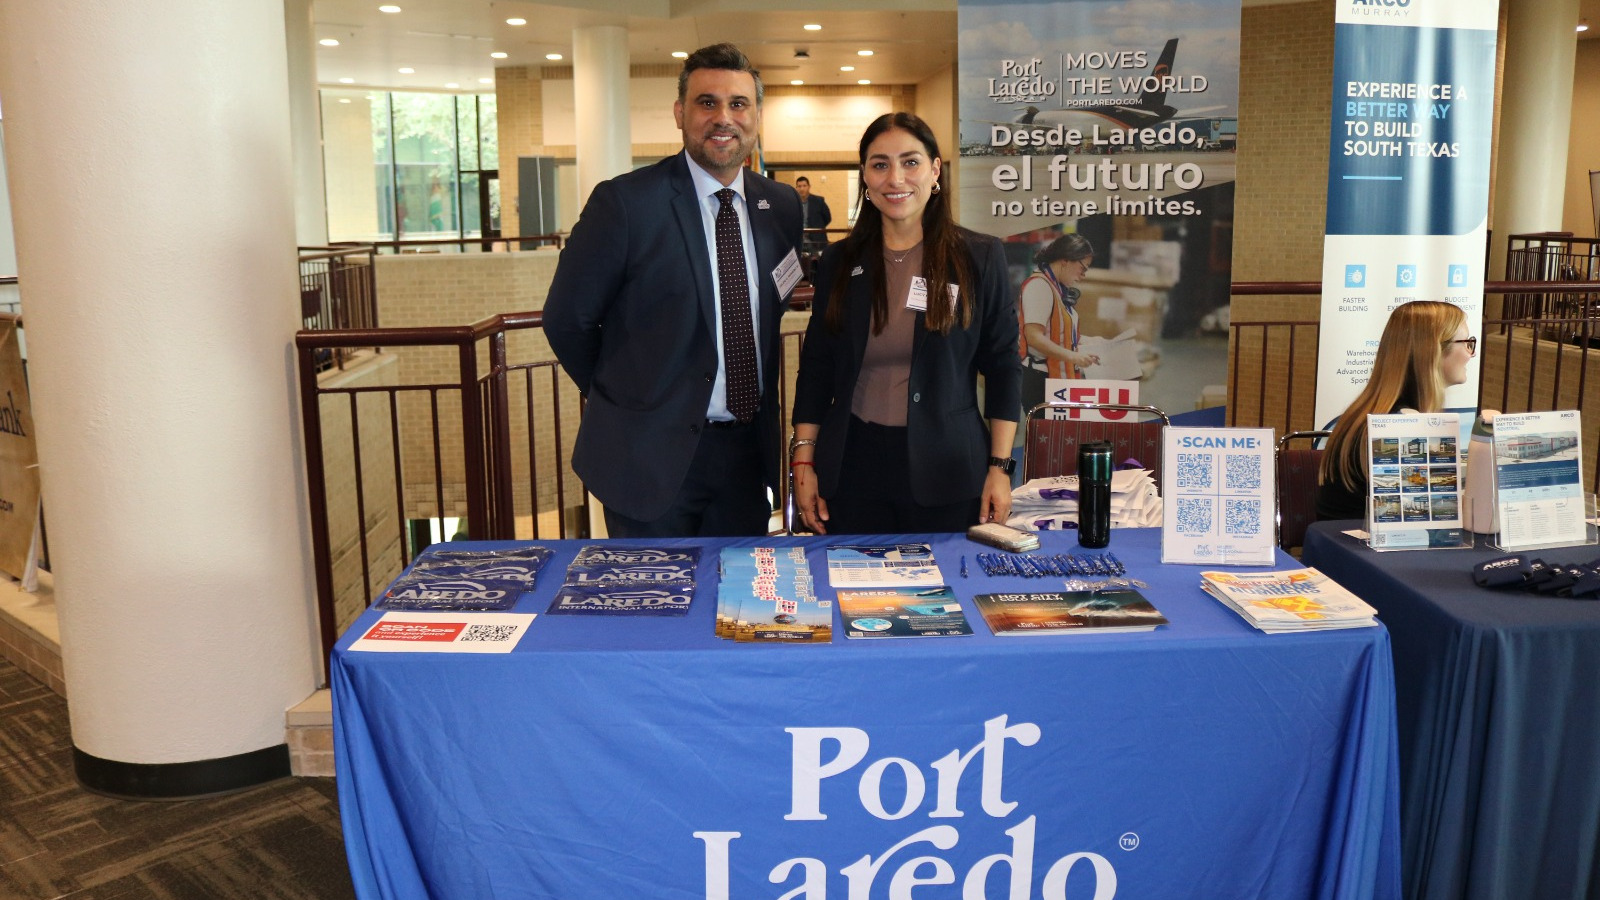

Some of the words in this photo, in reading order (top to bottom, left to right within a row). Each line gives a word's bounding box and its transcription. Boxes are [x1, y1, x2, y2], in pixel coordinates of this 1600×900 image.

[1352, 8, 1410, 17] MURRAY
[1002, 58, 1042, 77] Port
[1067, 51, 1148, 70] MOVES
[988, 75, 1056, 97] Laredo
[1067, 77, 1112, 95] THE
[1119, 75, 1208, 94] WORLD
[1347, 81, 1452, 100] EXPERIENCE
[1456, 86, 1468, 100] A
[1067, 98, 1143, 107] PORTLAREDO.COM
[1346, 101, 1408, 118] BETTER
[1412, 103, 1451, 119] WAY
[991, 125, 1083, 147] Desde
[1093, 122, 1205, 149] Laredo,
[1344, 121, 1369, 137] TO
[1373, 122, 1423, 138] BUILD
[1344, 140, 1402, 157] SOUTH
[1407, 142, 1460, 158] TEXAS
[992, 155, 1033, 191] el
[1048, 155, 1205, 191] futuro
[992, 200, 1025, 217] no
[1032, 196, 1098, 217] tiene
[1107, 195, 1202, 217] limites.
[1350, 377, 1370, 385] Sport
[1070, 388, 1130, 420] FU
[1183, 436, 1226, 448] SCAN
[1231, 437, 1255, 449] ME
[561, 595, 691, 607] LAREDO
[784, 713, 1041, 821] Port
[692, 815, 1118, 900] Laredo
